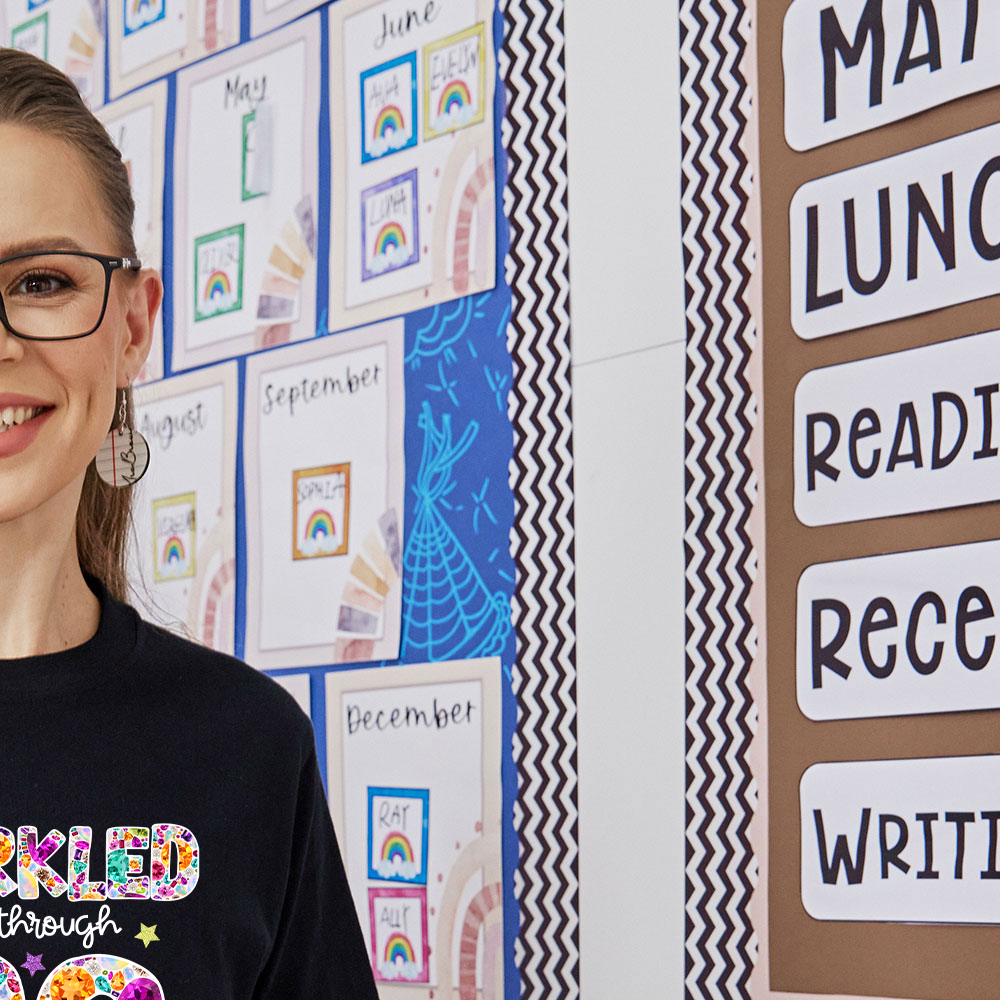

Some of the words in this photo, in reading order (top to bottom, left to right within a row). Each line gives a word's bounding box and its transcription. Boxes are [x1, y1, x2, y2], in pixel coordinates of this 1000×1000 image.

[374, 0, 440, 49] June
[223, 73, 267, 110] May
[262, 363, 383, 415] September
[140, 402, 208, 450] August
[347, 699, 475, 733] December
